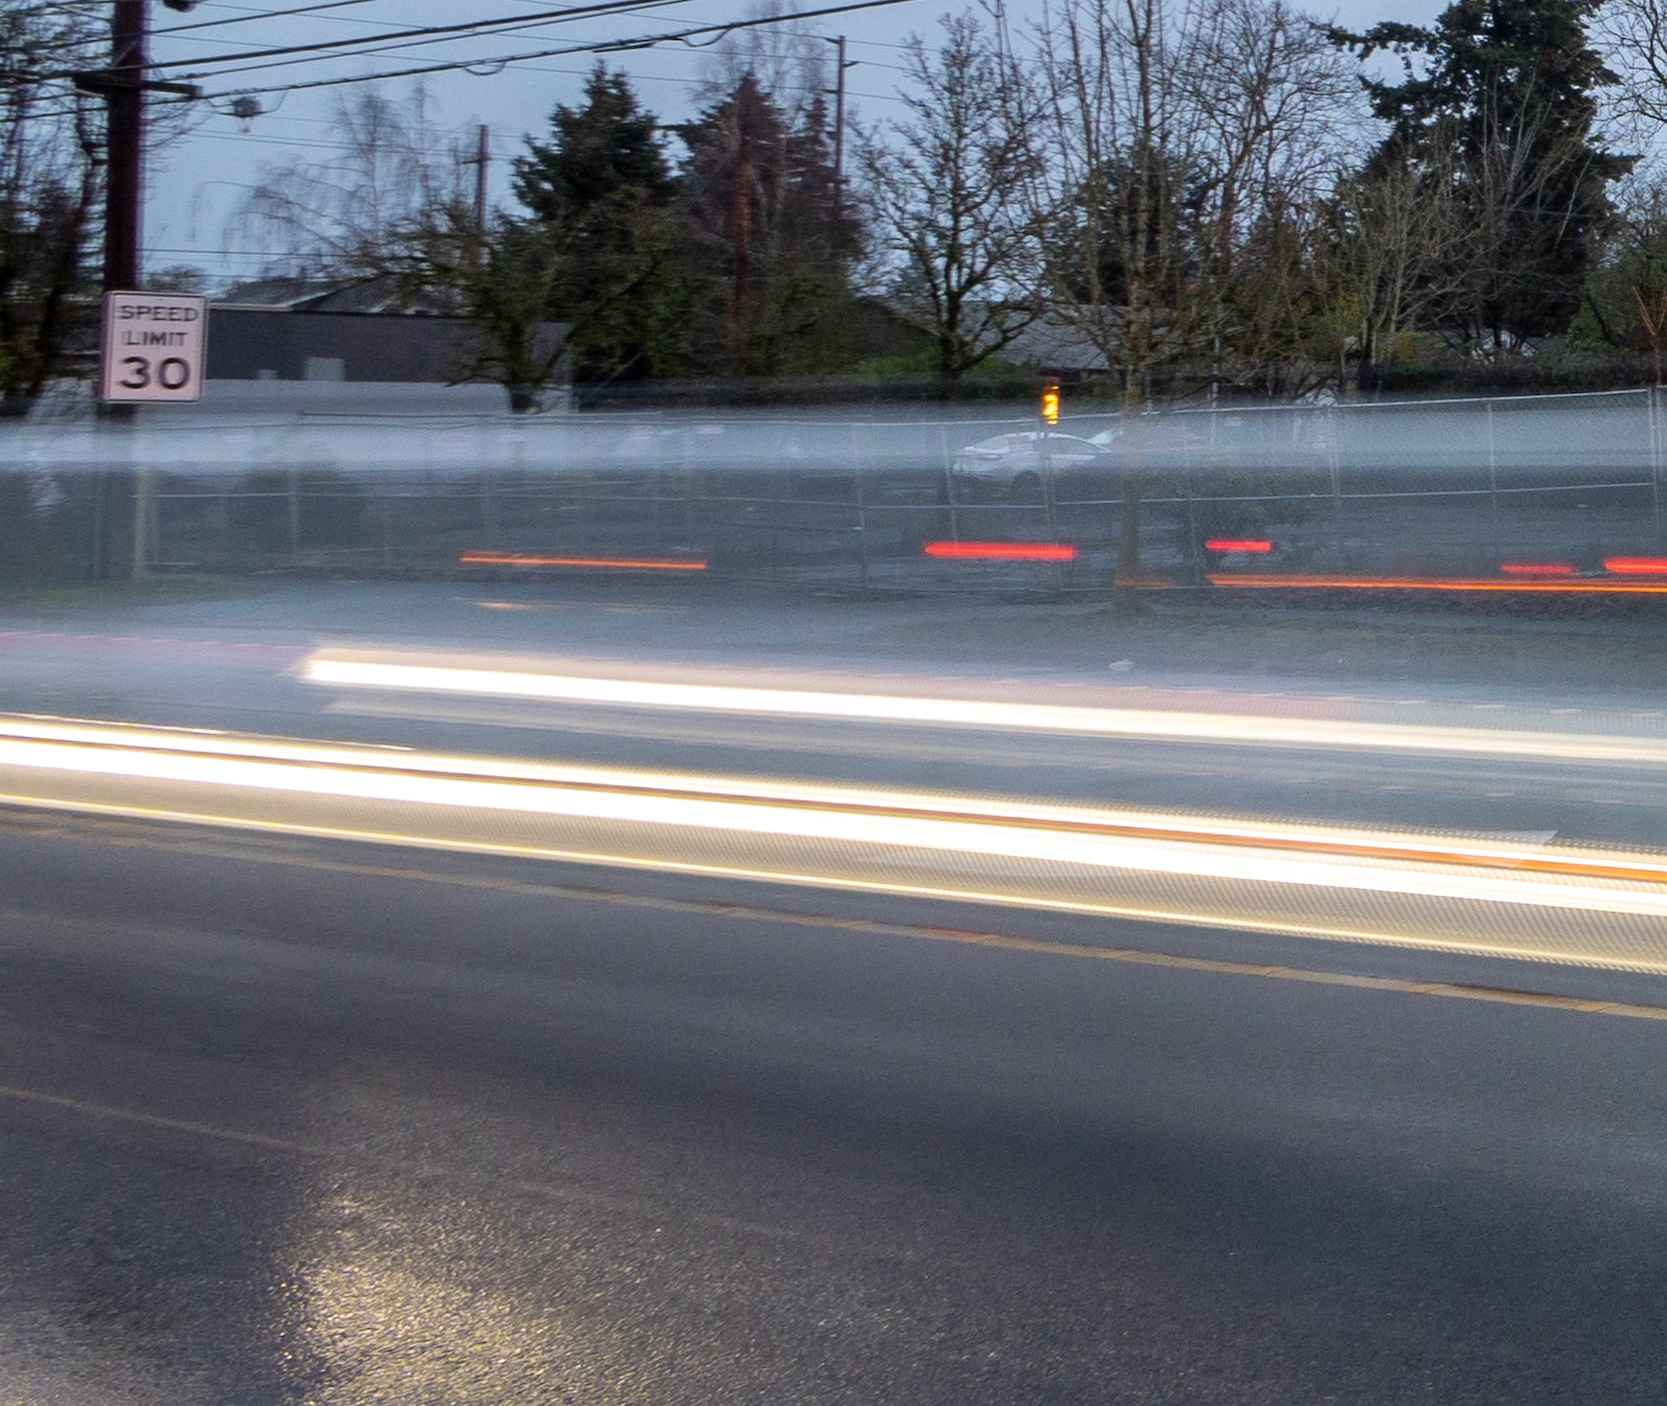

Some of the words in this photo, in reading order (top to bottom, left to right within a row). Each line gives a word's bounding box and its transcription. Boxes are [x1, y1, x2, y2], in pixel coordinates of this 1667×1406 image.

[117, 304, 199, 322] SPEED
[125, 330, 188, 347] LIMIT
[119, 356, 191, 390] 30
